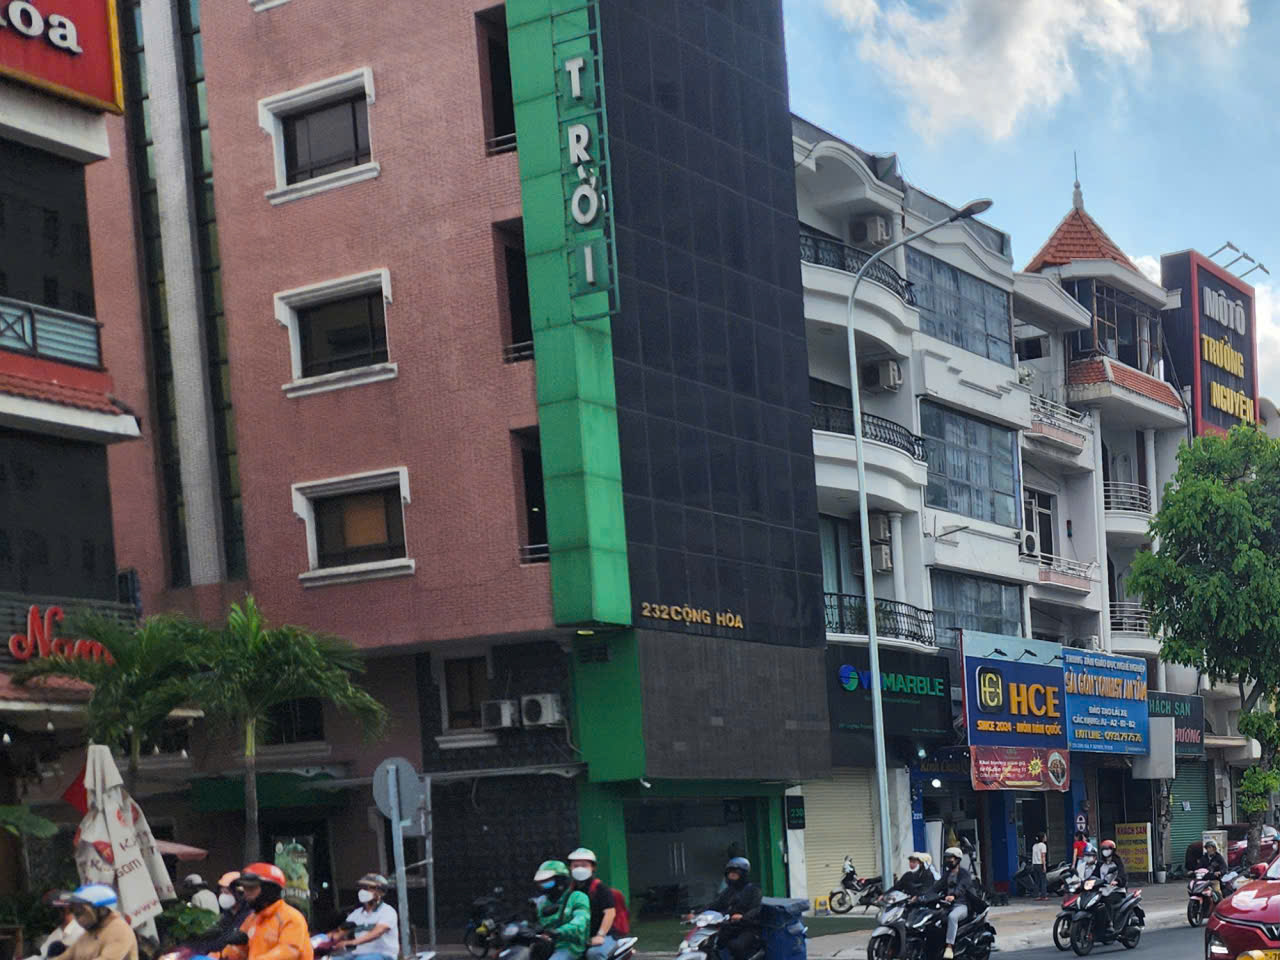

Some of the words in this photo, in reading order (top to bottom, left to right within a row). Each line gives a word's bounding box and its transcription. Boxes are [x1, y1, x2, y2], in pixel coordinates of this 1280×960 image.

[1200, 333, 1244, 379] TRƯỜNG
[1210, 381, 1255, 424] NGUYÊN
[641, 602, 670, 619] 232
[670, 604, 712, 626] CỘNG
[716, 609, 744, 629] HÒA
[9, 604, 117, 668] Nam
[1065, 666, 1078, 693] SÀI
[1078, 667, 1095, 695] GÒN
[1094, 674, 1123, 699] TOURIST
[1008, 682, 1061, 718] HCE
[1148, 696, 1171, 714] HÁCH
[1174, 699, 1191, 719] SẠN
[976, 720, 995, 732] SINCE
[996, 721, 1012, 732] 2024
[1044, 722, 1063, 736] QUỐC
[790, 807, 804, 817] 230
